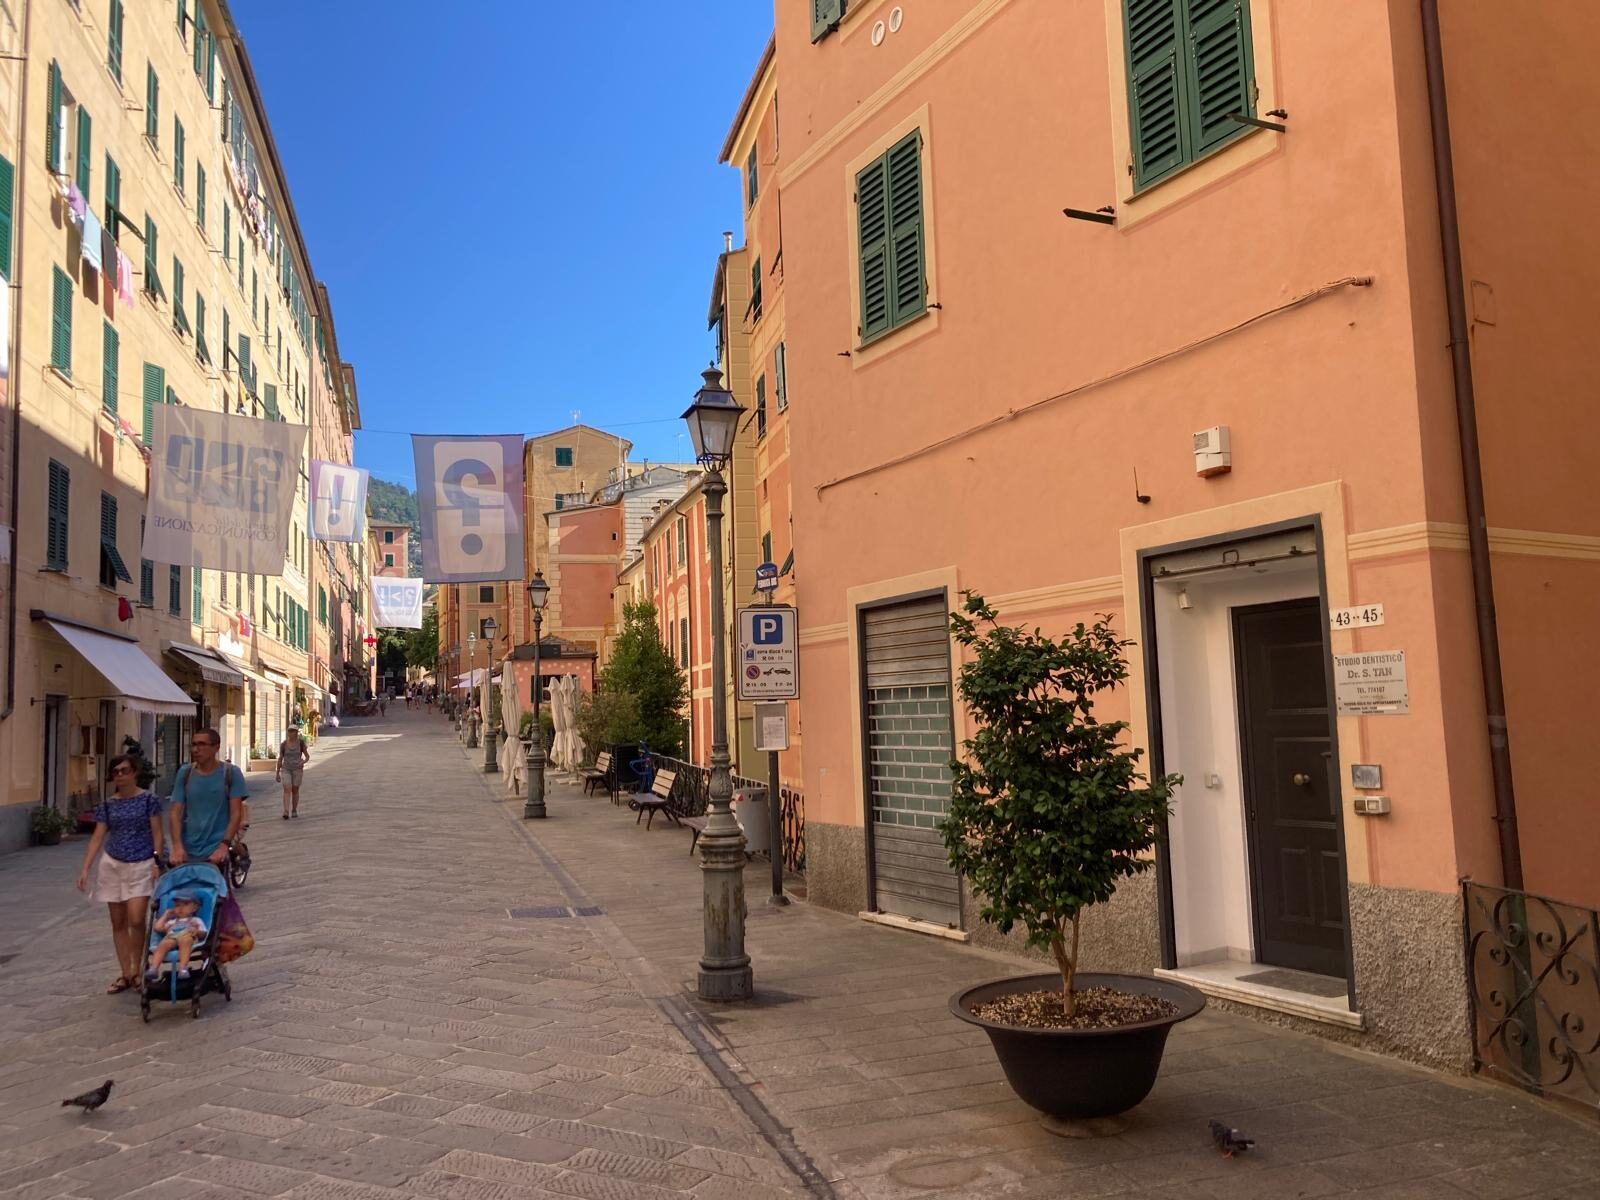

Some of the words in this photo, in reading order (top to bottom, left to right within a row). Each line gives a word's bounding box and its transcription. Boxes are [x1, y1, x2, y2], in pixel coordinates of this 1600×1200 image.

[1336, 612, 1350, 625] 43
[1362, 608, 1377, 622] 45
[760, 618, 776, 640] P
[1337, 656, 1361, 667] STUDIO
[1362, 654, 1402, 664] DENTISTICO
[1347, 670, 1361, 679] Dr.
[1362, 668, 1372, 678] S.
